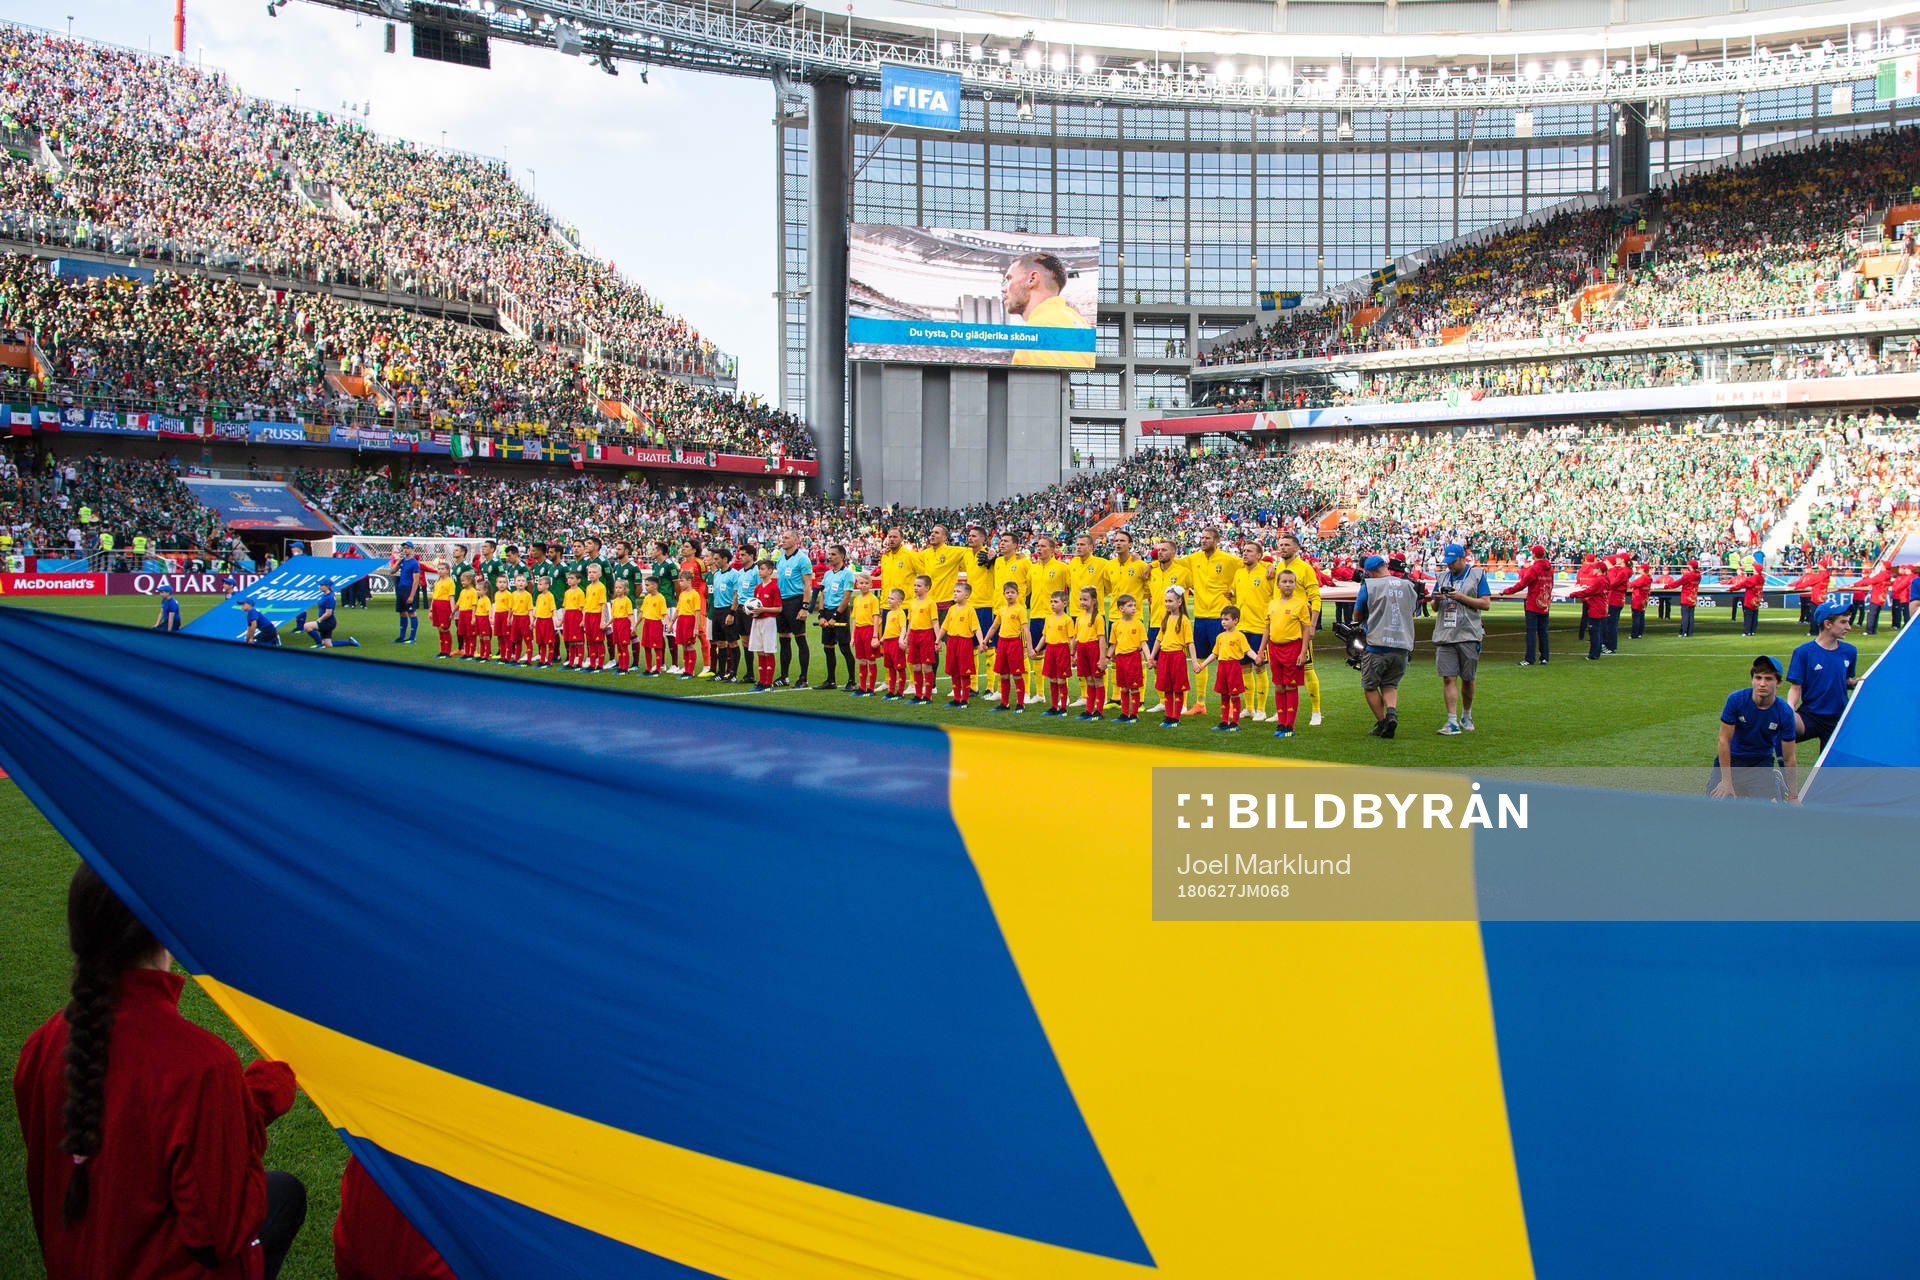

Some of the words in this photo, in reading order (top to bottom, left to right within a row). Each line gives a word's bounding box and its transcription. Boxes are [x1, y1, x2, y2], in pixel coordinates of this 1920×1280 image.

[893, 85, 949, 112] FIFA
[909, 327, 922, 337] Du
[924, 328, 948, 339] tysta,
[950, 329, 963, 339] Du
[966, 329, 1009, 342] glädjerika
[1010, 333, 1039, 342] sköna!
[263, 427, 306, 441] RUSSI
[13, 578, 95, 590] McDonald's
[133, 574, 217, 595] QATAR
